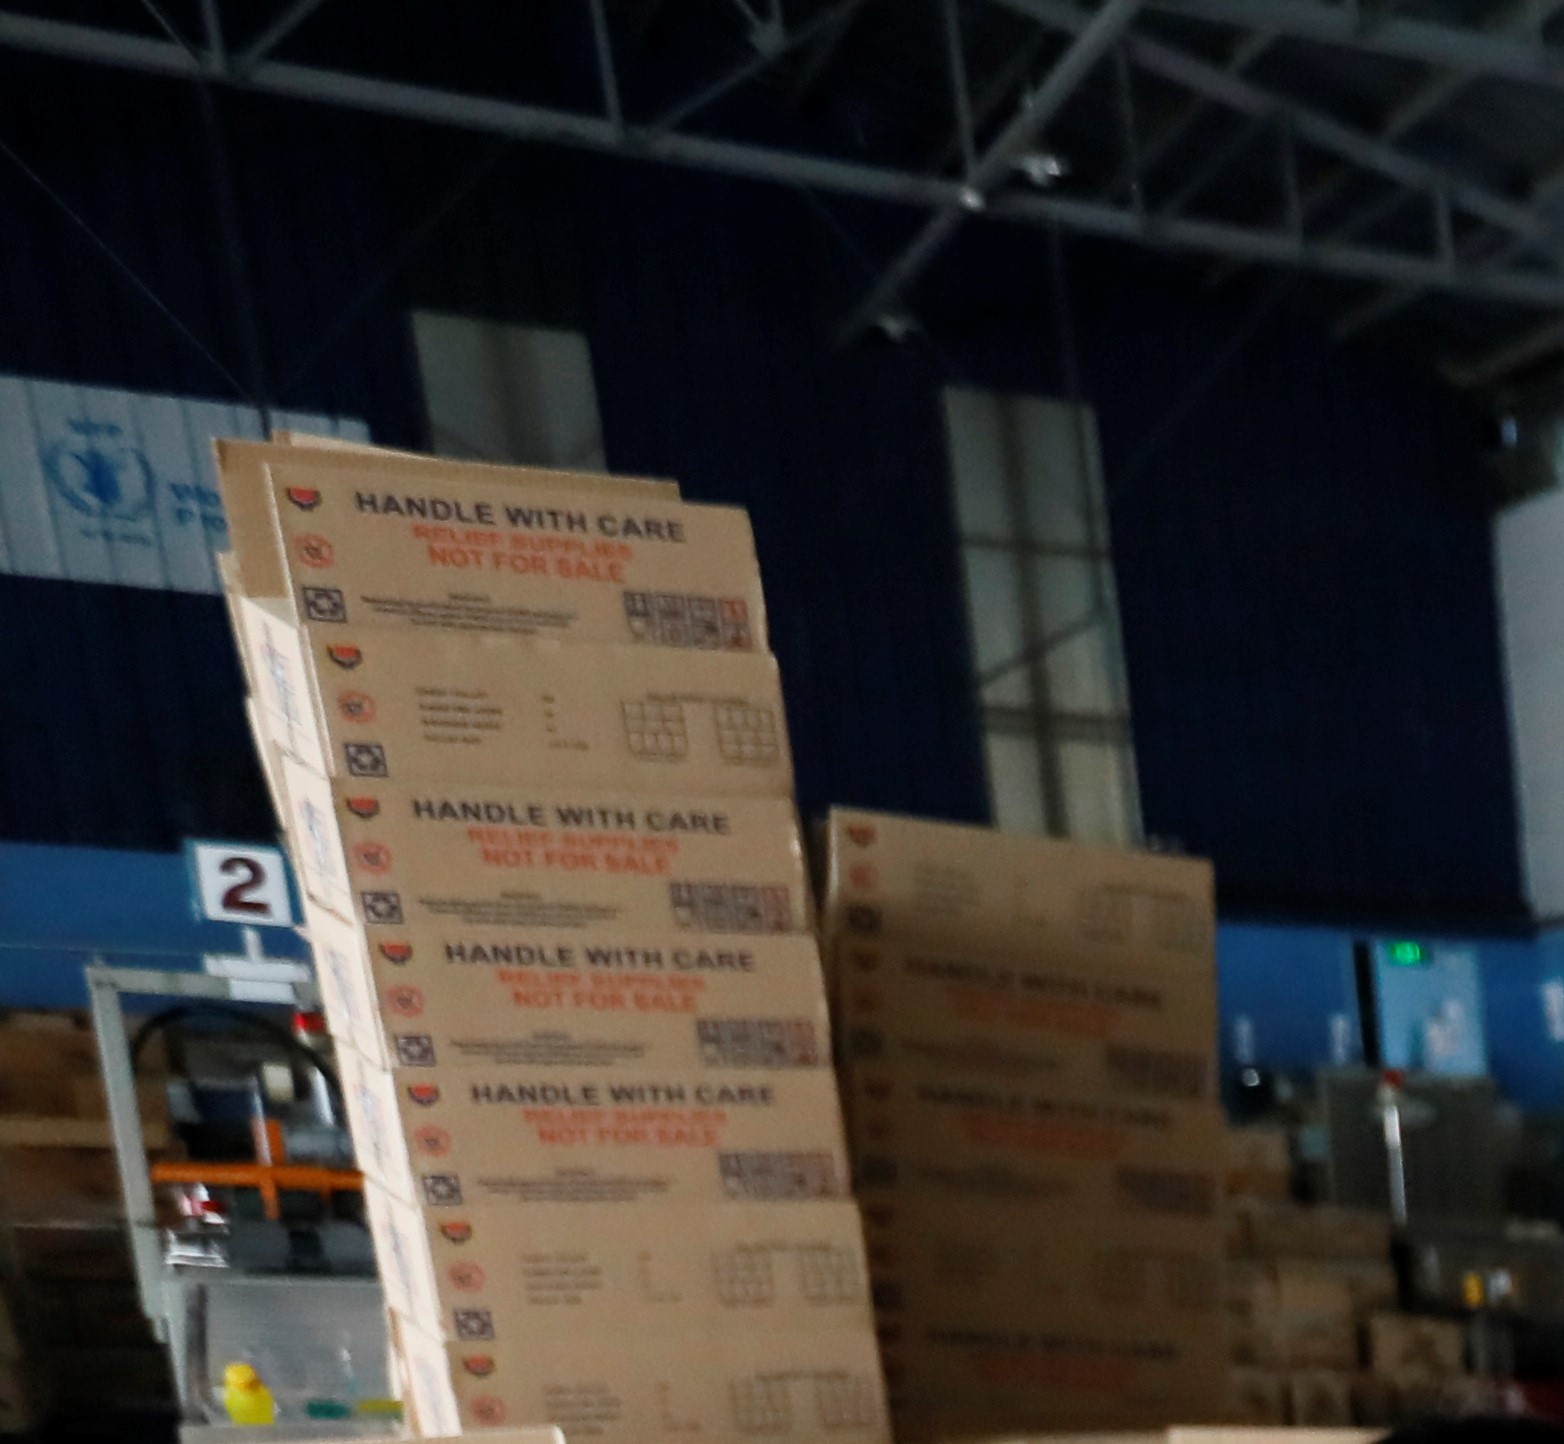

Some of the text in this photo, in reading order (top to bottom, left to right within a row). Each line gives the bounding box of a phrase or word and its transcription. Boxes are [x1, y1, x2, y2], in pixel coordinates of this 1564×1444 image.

[355, 492, 686, 544] HANDLE WITH CARE
[428, 545, 624, 582] NOT FOR SALE
[412, 799, 730, 836] HANDLE WITH CARE
[218, 856, 271, 915] 2
[444, 942, 755, 972] HANDLE WITH CARE
[472, 1084, 775, 1106] HANDLE WITH CARE
